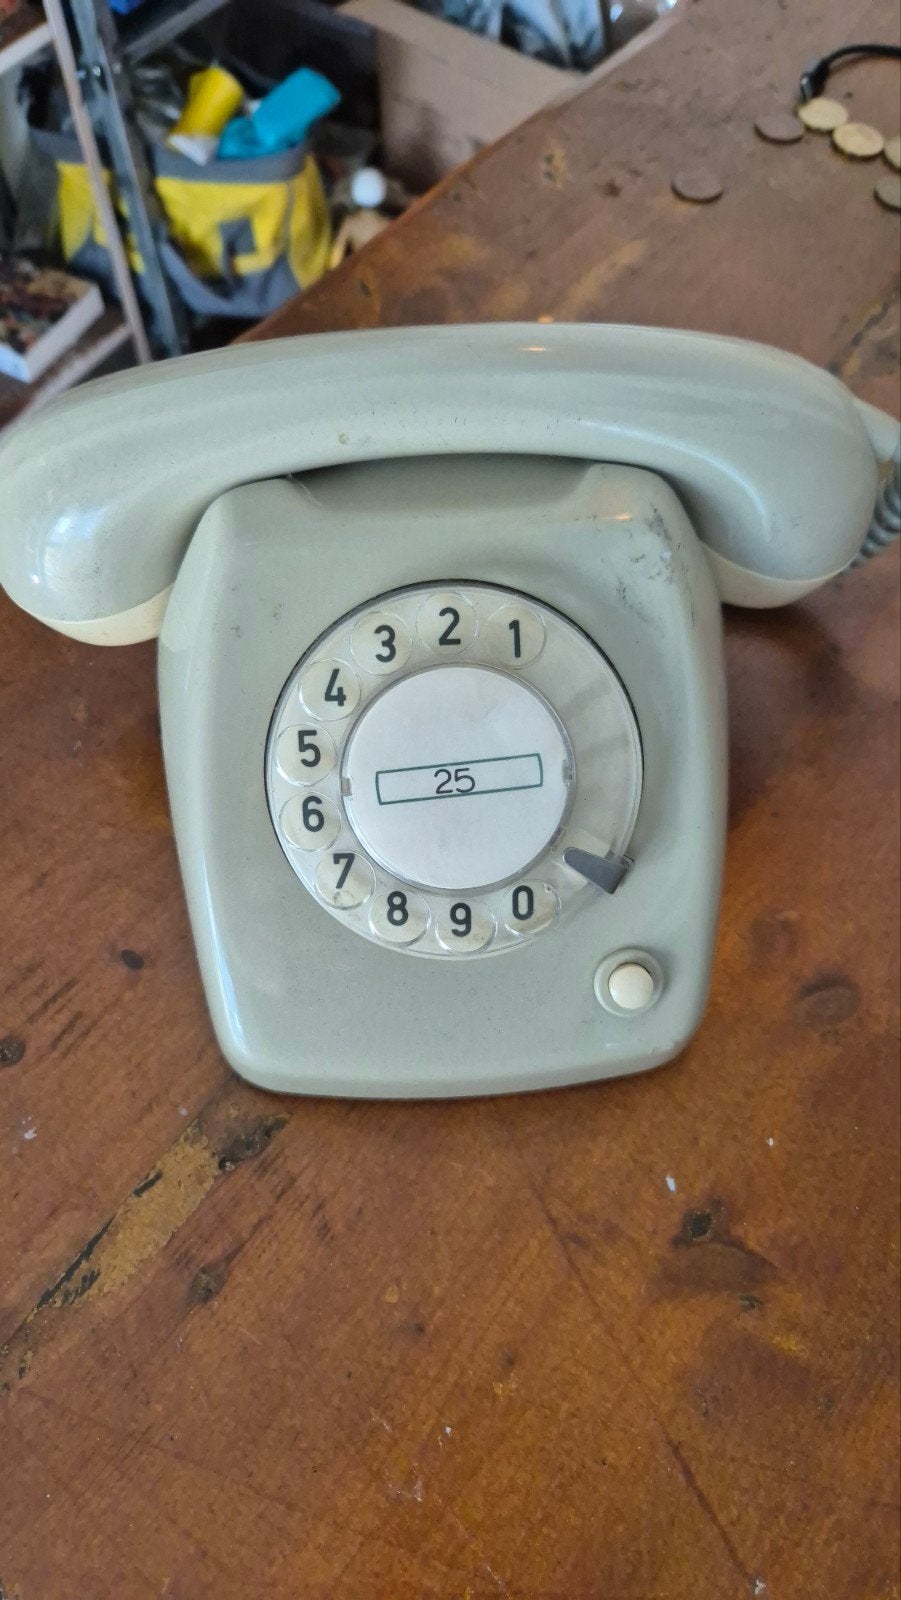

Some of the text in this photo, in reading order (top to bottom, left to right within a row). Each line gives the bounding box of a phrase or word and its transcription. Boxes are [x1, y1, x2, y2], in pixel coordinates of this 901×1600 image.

[375, 625, 396, 662] 3
[439, 607, 461, 645] 2
[509, 620, 521, 658] 1
[325, 669, 346, 706] 4
[298, 730, 320, 767] 5
[433, 768, 476, 794] 25
[303, 796, 324, 832] 6
[334, 853, 355, 888] 7
[387, 891, 408, 926] 8
[450, 902, 471, 937] 9
[513, 885, 534, 920] 0
